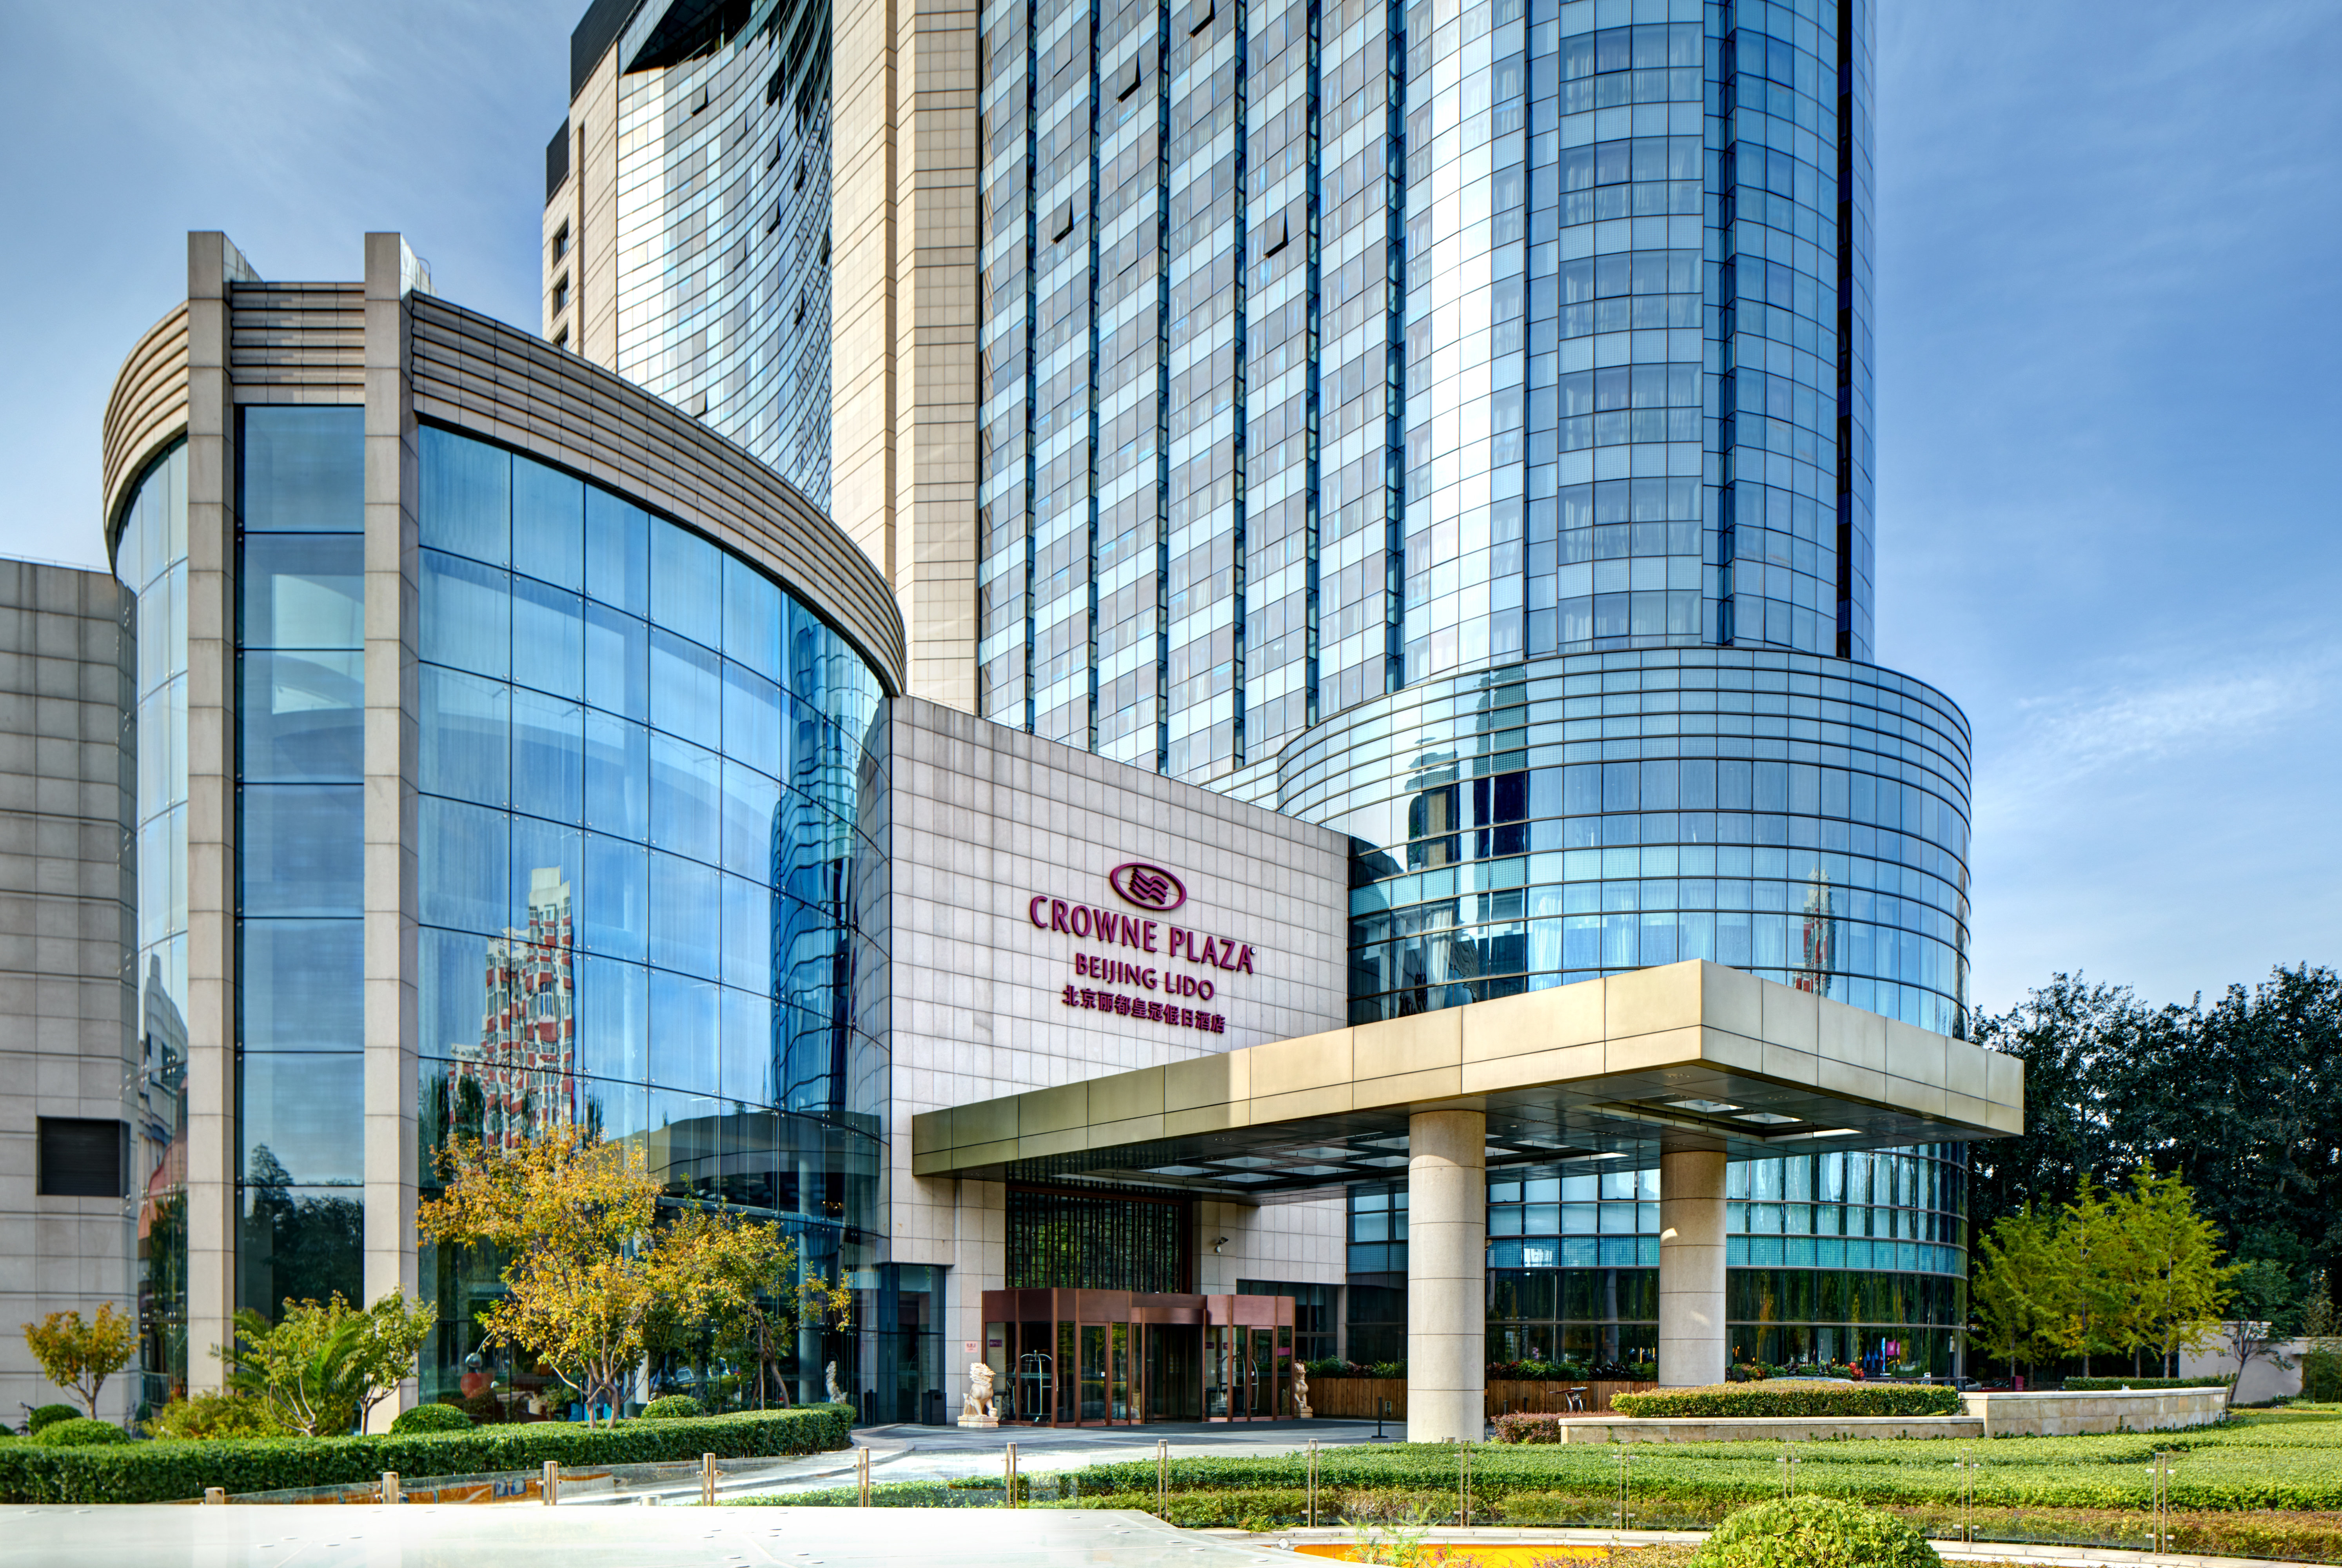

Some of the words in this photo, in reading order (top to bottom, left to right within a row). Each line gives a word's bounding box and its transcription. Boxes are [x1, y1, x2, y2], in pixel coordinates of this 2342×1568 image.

[1029, 896, 1158, 953] CROWNE
[1075, 953, 1157, 989] BEIJING
[1165, 972, 1215, 1001] LIDO
[1062, 985, 1226, 1034] 北京丽都皇冠假日酒店
